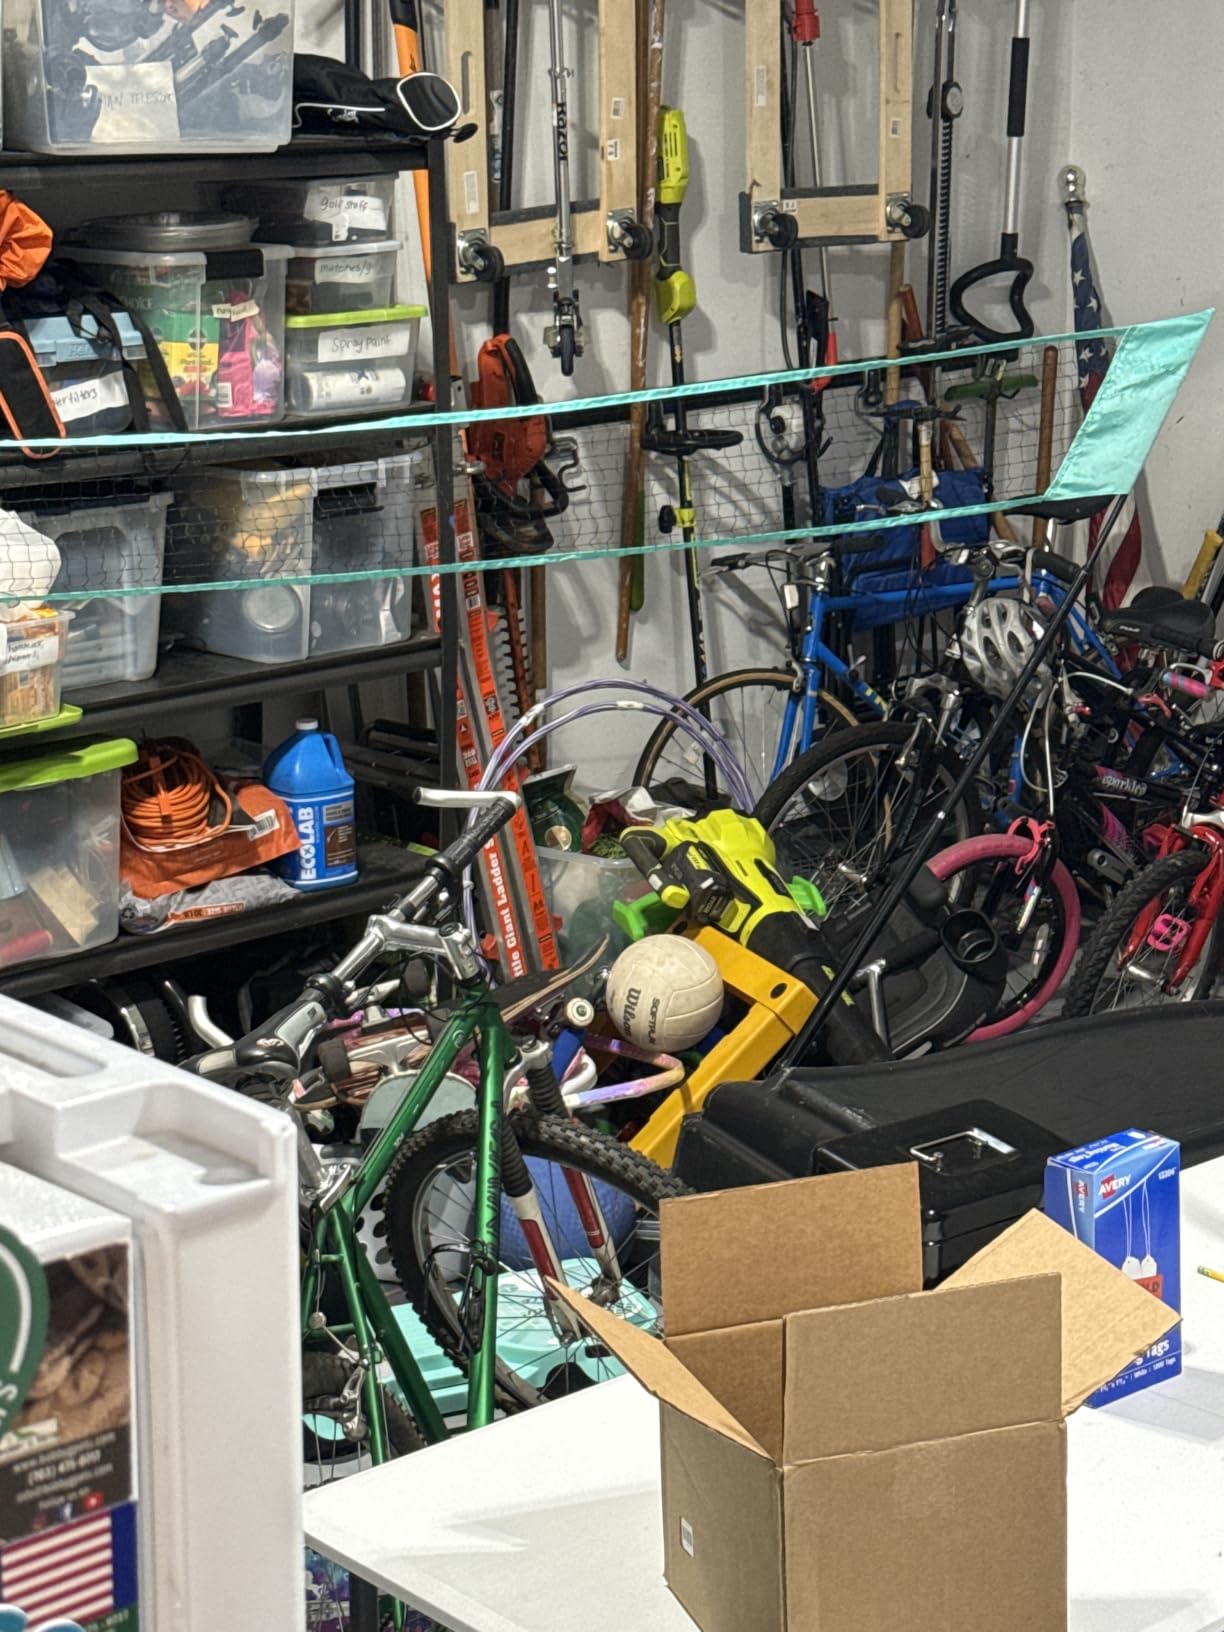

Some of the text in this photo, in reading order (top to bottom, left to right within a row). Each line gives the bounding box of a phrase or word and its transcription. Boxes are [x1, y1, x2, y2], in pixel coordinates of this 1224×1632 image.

[556, 102, 569, 161] Razor
[298, 806, 317, 880] ECOLAB
[489, 852, 508, 906] Ladder
[500, 908, 518, 949] Giant
[623, 987, 642, 1038] Wilson
[1077, 1180, 1086, 1213] AVERY
[1098, 1173, 1132, 1195] AVERY
